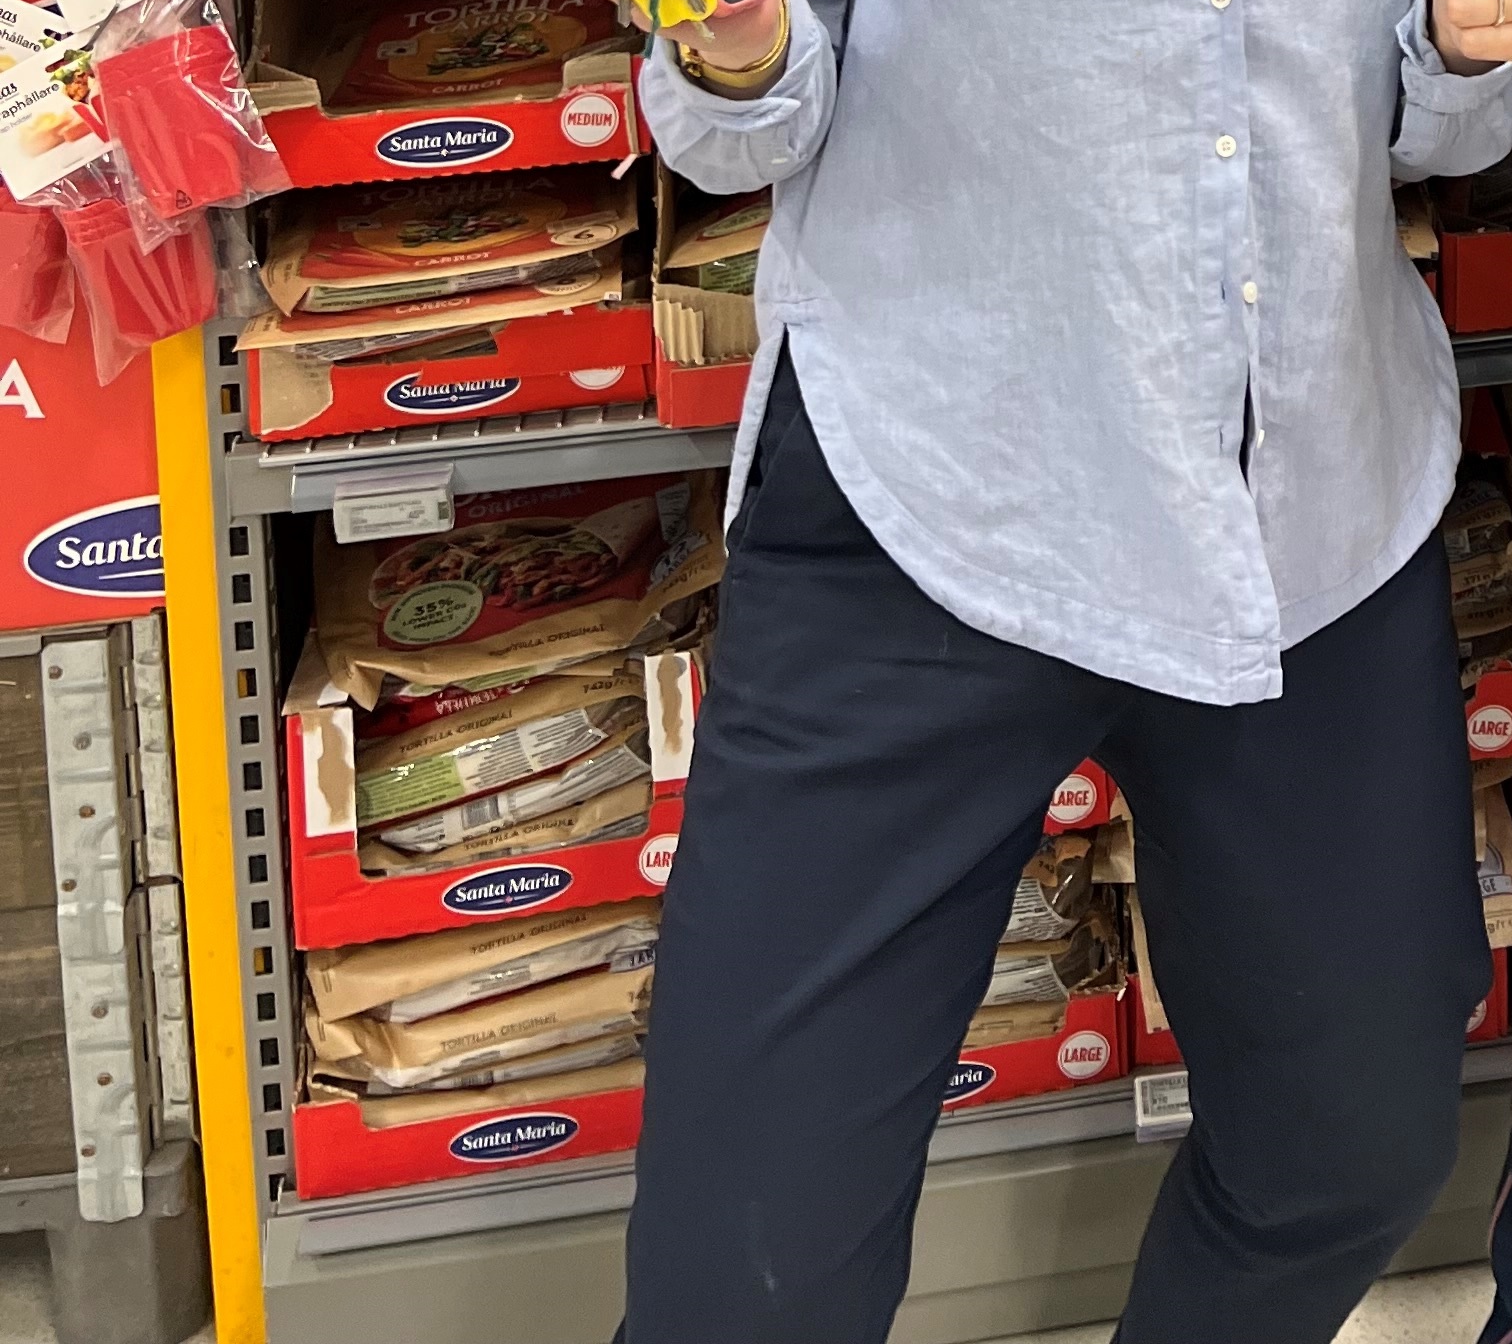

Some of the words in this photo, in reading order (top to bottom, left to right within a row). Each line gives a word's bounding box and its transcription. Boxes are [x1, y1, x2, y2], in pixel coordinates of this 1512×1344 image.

[432, 77, 505, 95] CARROT
[567, 110, 613, 128] MEDIUM
[414, 251, 492, 267] CARROT
[394, 295, 472, 314] CARROT
[412, 593, 456, 616] 35%
[414, 620, 457, 633] IMPACT
[489, 635, 541, 658] TORTILLA
[545, 623, 607, 645] ORIGINAL
[1471, 718, 1512, 738] LARGE
[1051, 790, 1090, 807] LARGE
[440, 1026, 498, 1050] TORTILLA
[501, 1012, 559, 1036] ORIGINAL
[1064, 1047, 1103, 1063] LARGE
